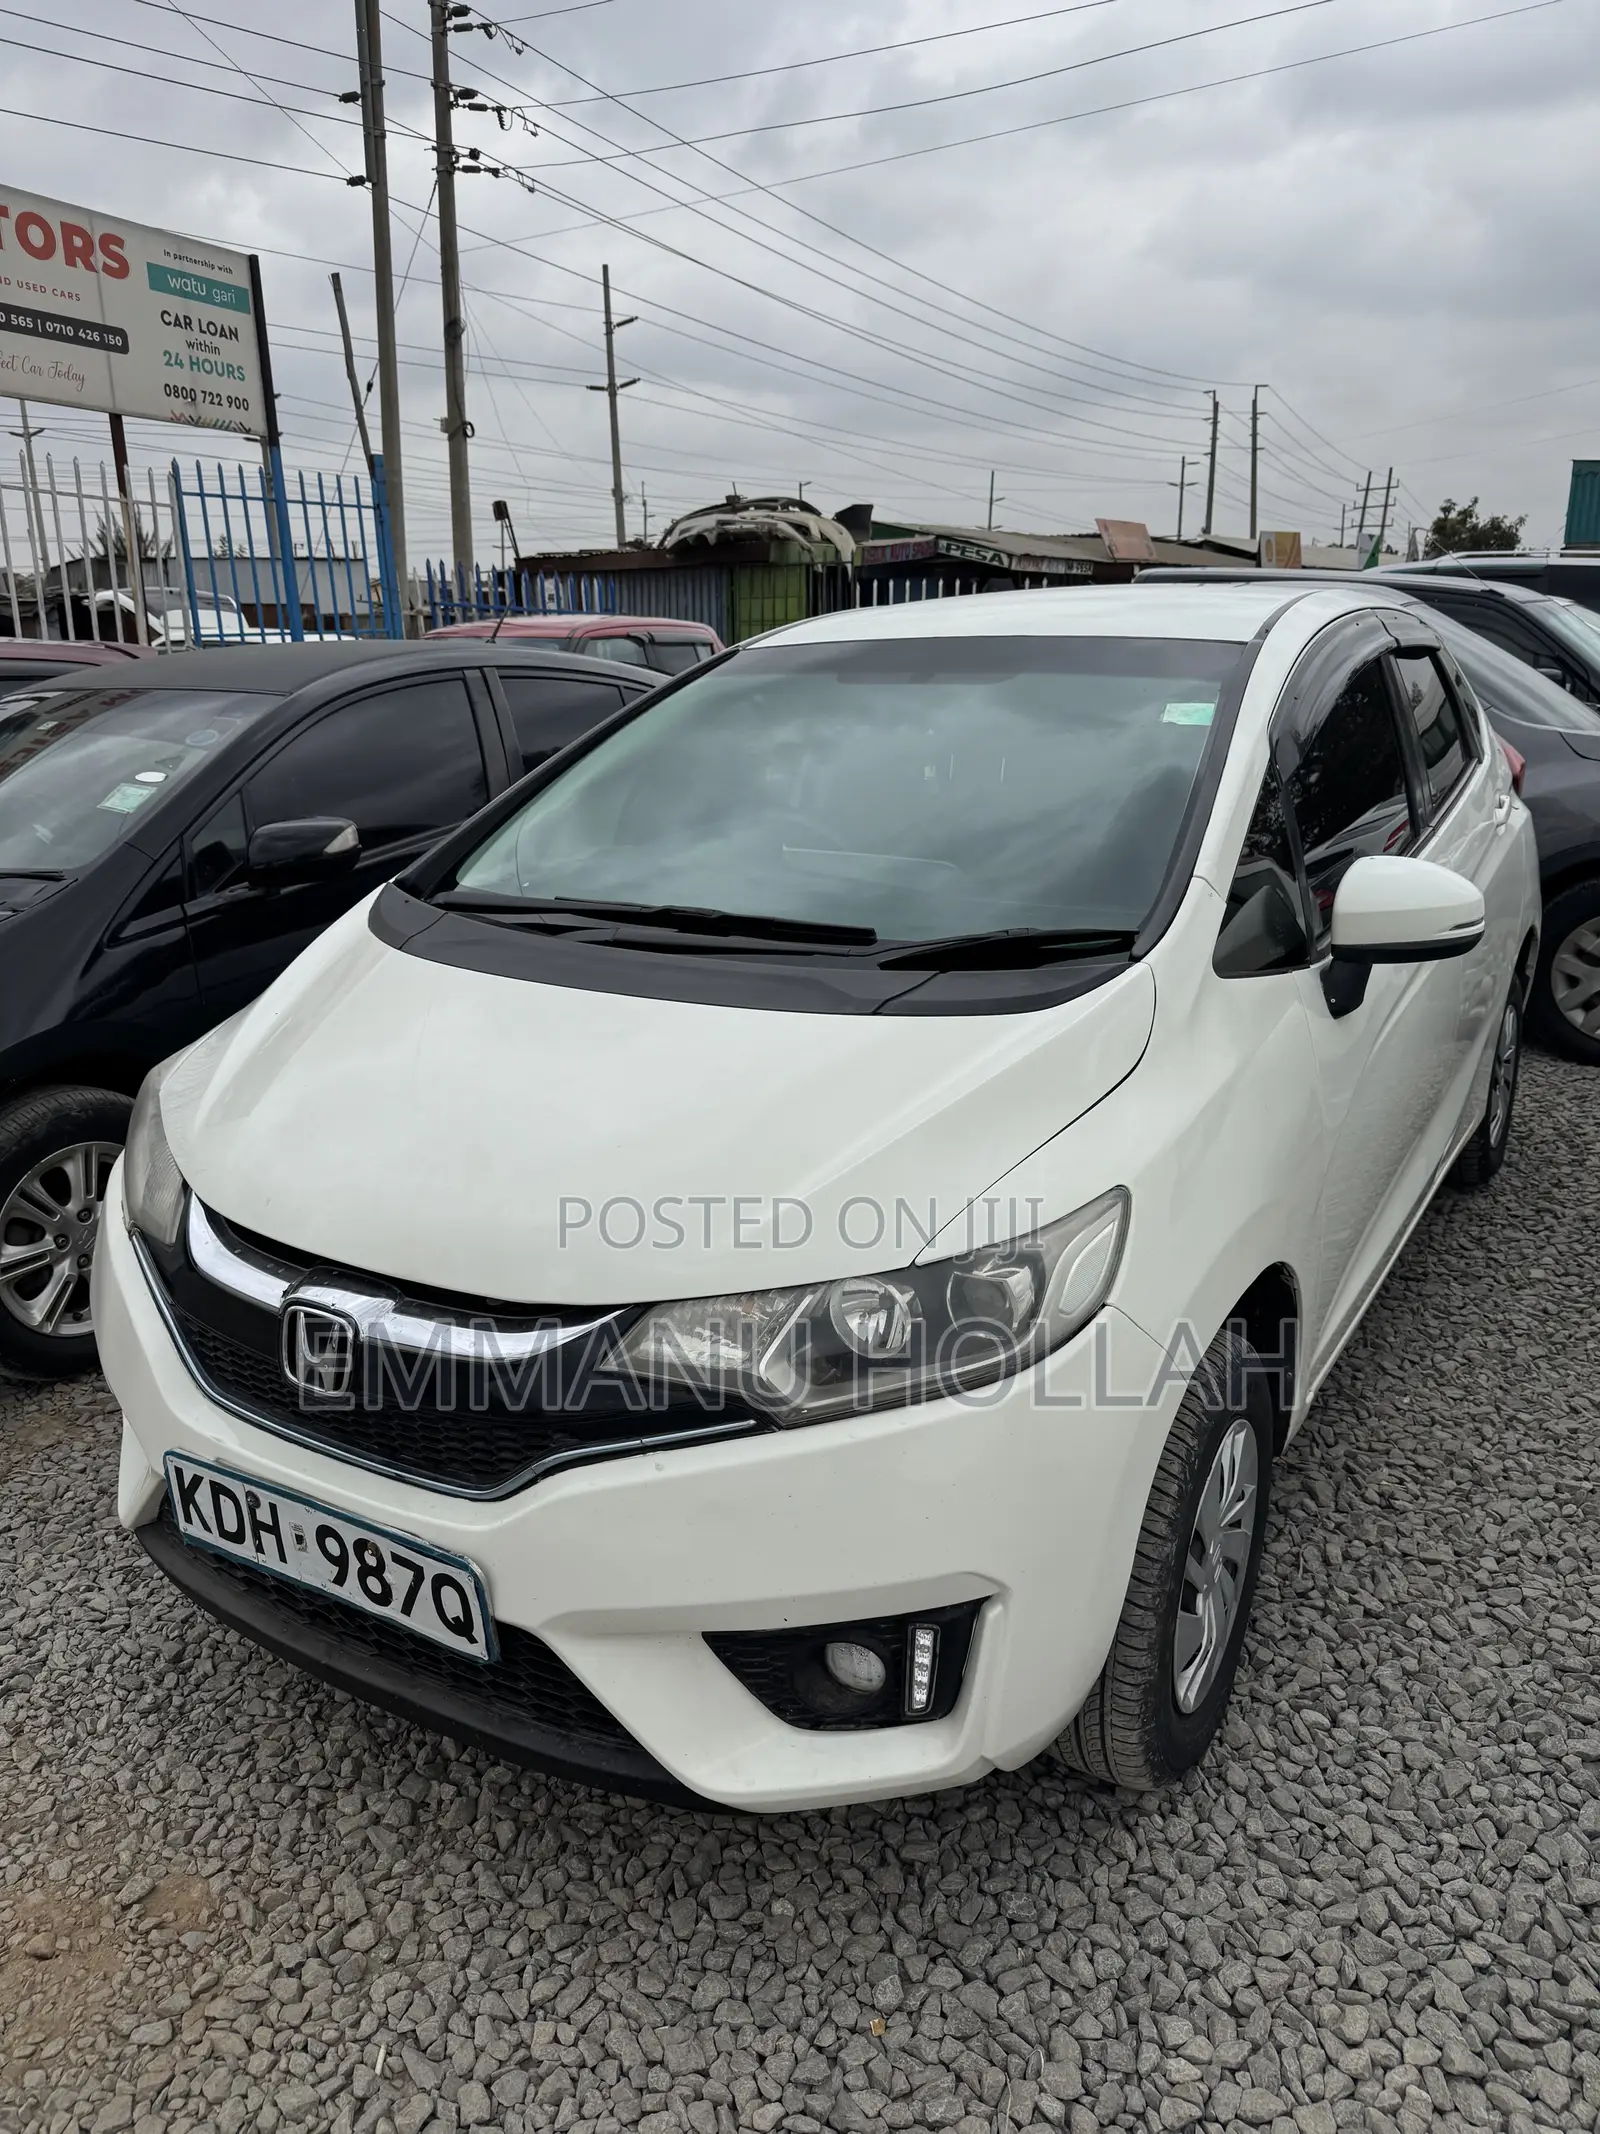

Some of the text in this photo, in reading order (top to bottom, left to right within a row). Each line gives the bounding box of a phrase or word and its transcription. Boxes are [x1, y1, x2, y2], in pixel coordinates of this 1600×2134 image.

[163, 249, 234, 275] In partnership with
[17, 279, 47, 294] USED
[52, 288, 81, 302] CARS
[167, 274, 236, 304] watu gari
[10, 313, 34, 328] 565
[46, 321, 74, 337] 0710
[78, 328, 101, 342] 426
[103, 333, 123, 346] 150
[160, 309, 239, 342] CAR LOAN
[185, 338, 221, 356] within
[22, 355, 44, 377] Car
[47, 360, 86, 392] Today
[163, 349, 246, 382] 24 HOURS
[164, 382, 249, 412] 0800 722 900
[174, 1464, 479, 1645] KDH 987Q
